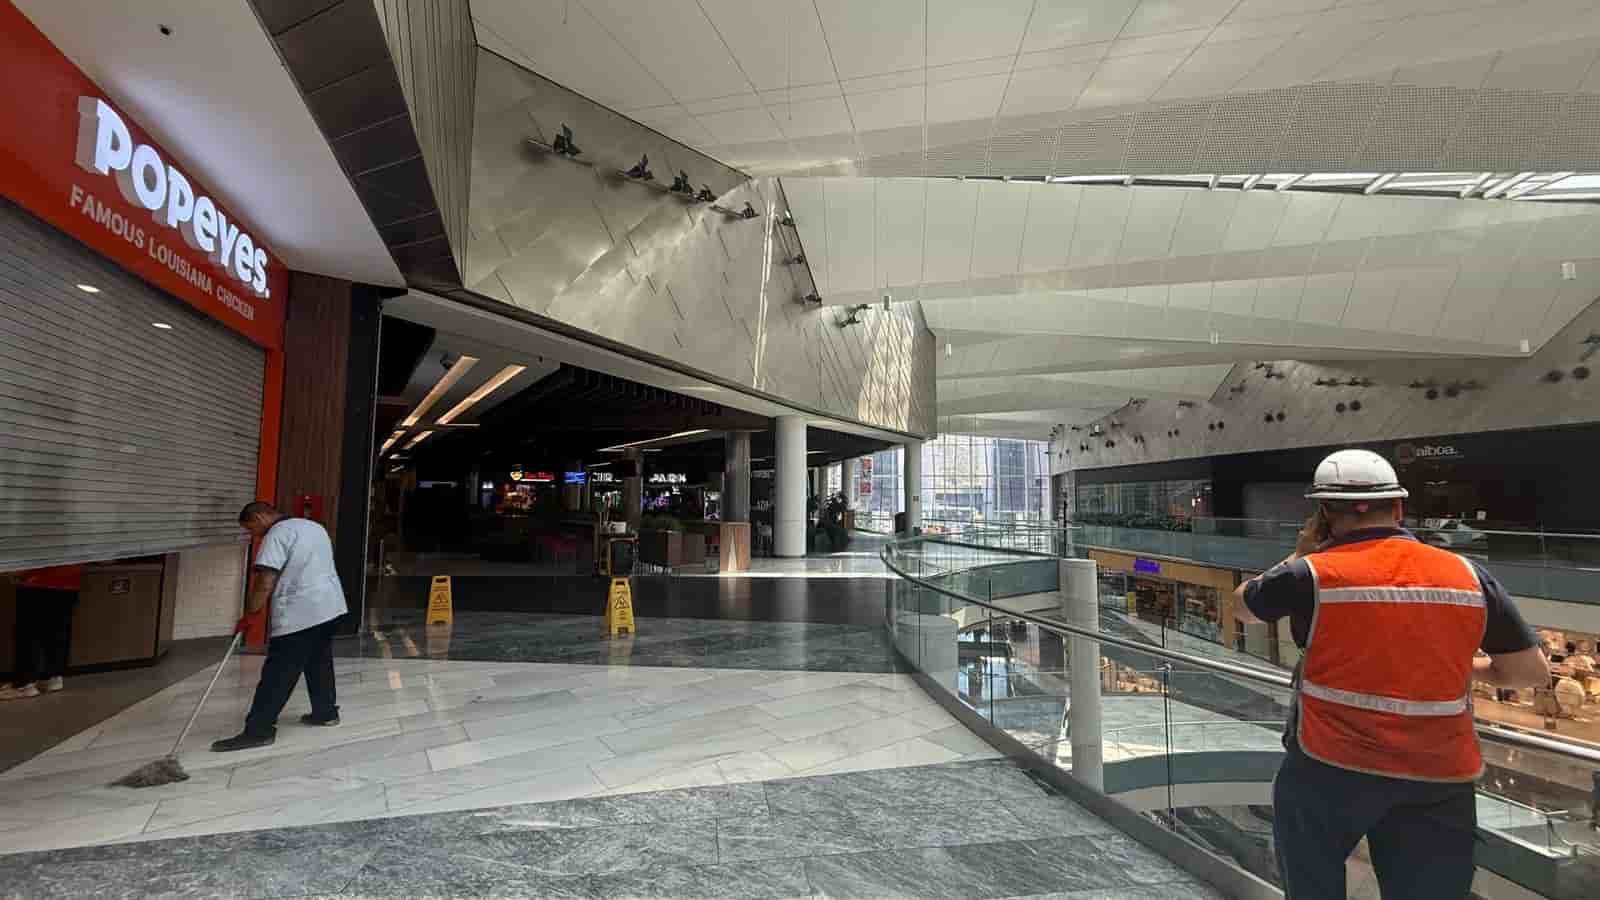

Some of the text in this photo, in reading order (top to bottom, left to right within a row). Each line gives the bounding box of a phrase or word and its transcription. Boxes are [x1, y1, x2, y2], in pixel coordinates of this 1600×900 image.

[70, 184, 255, 321] FAMOUS LOUISIANA CHICKEN
